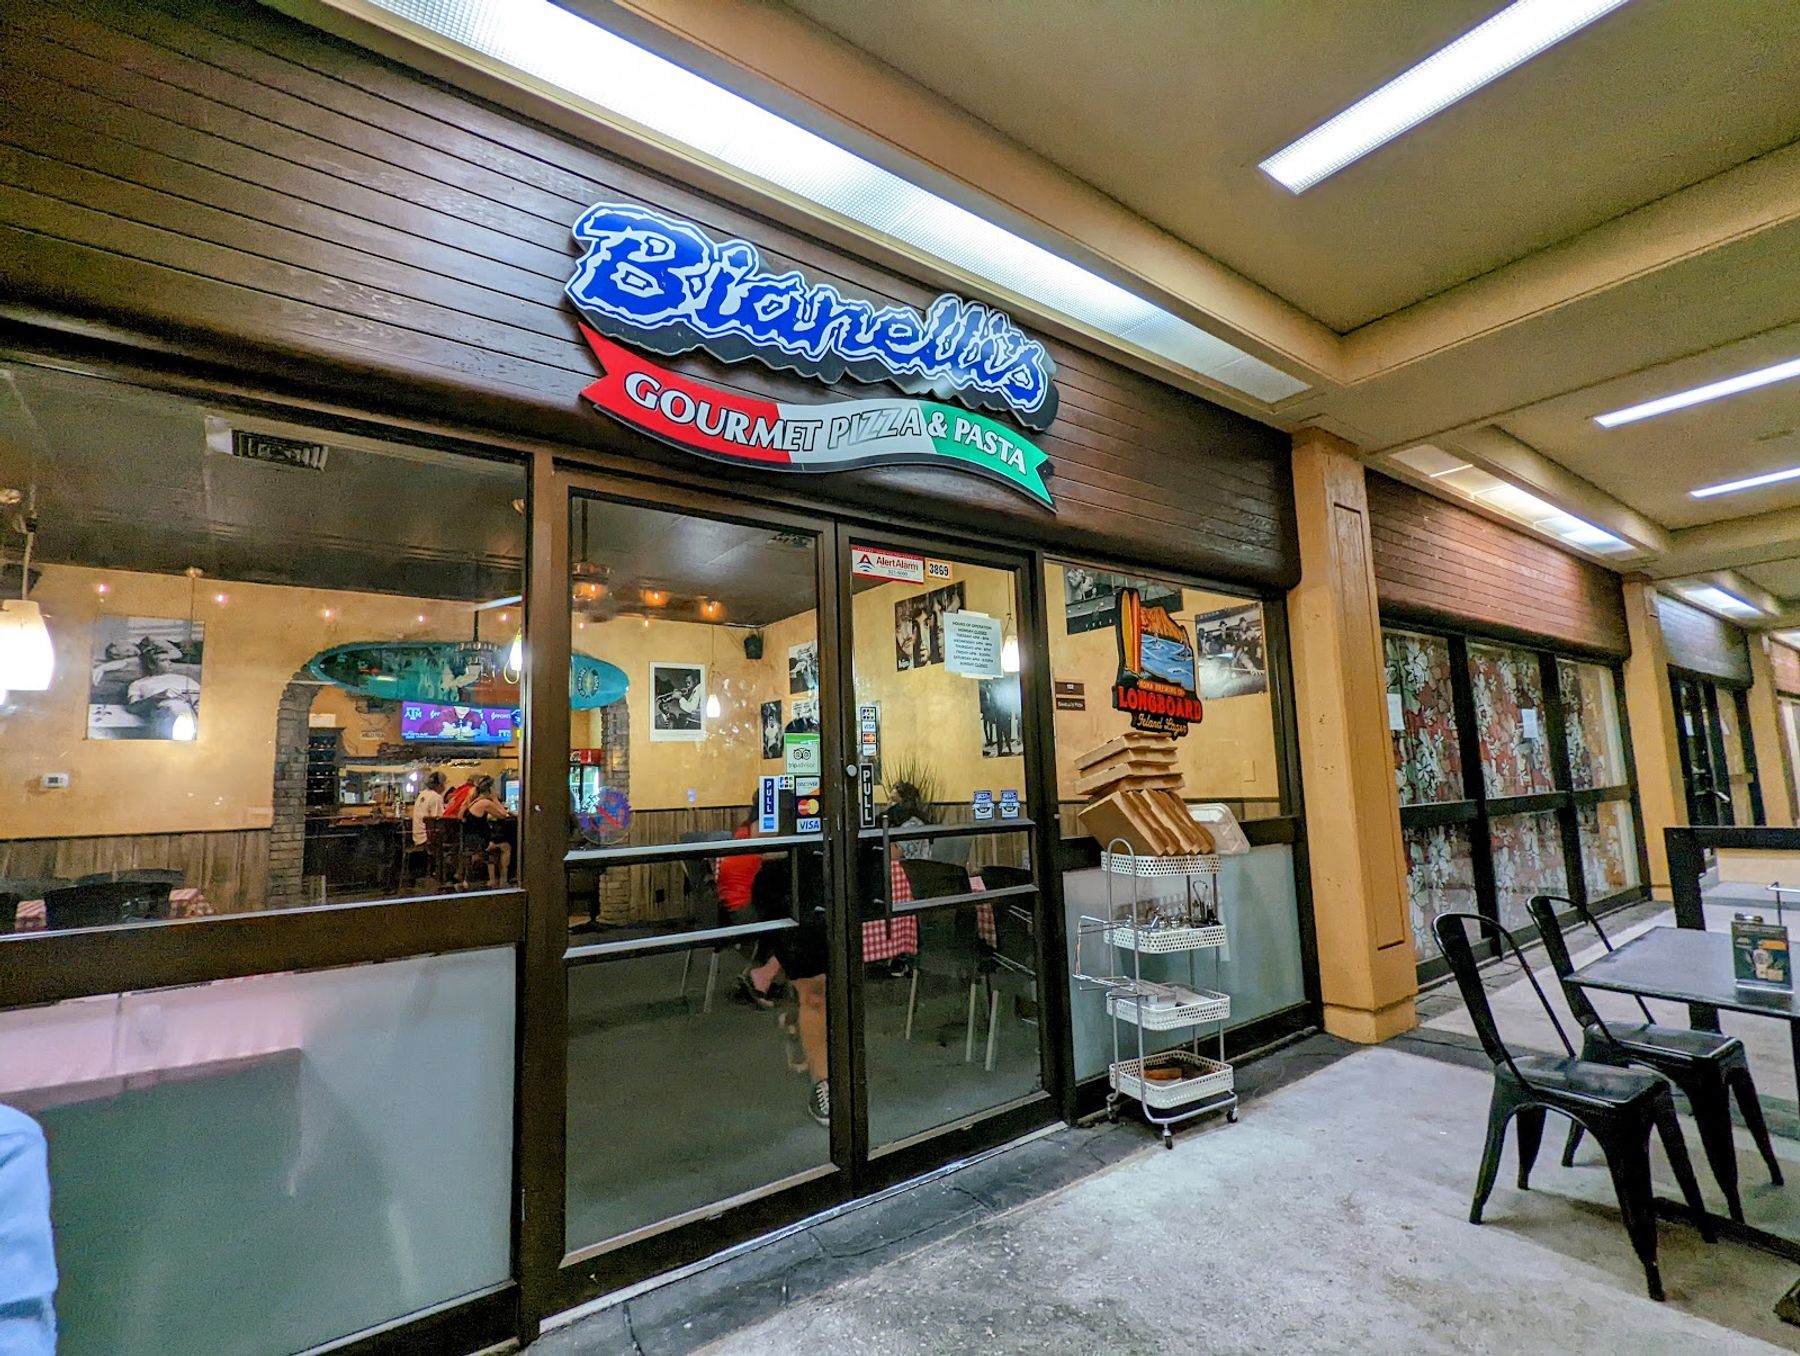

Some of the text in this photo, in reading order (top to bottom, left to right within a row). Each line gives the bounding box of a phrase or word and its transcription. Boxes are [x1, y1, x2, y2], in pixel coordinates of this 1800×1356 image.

[565, 203, 1048, 412] Bianelli's
[624, 371, 1028, 476] GOURMET PIZZA & PASTA
[929, 563, 949, 577] 3869
[1118, 686, 1201, 721] LONGBOARD
[1137, 713, 1163, 729] Island
[862, 770, 872, 821] PULL
[800, 820, 820, 830] VISA
